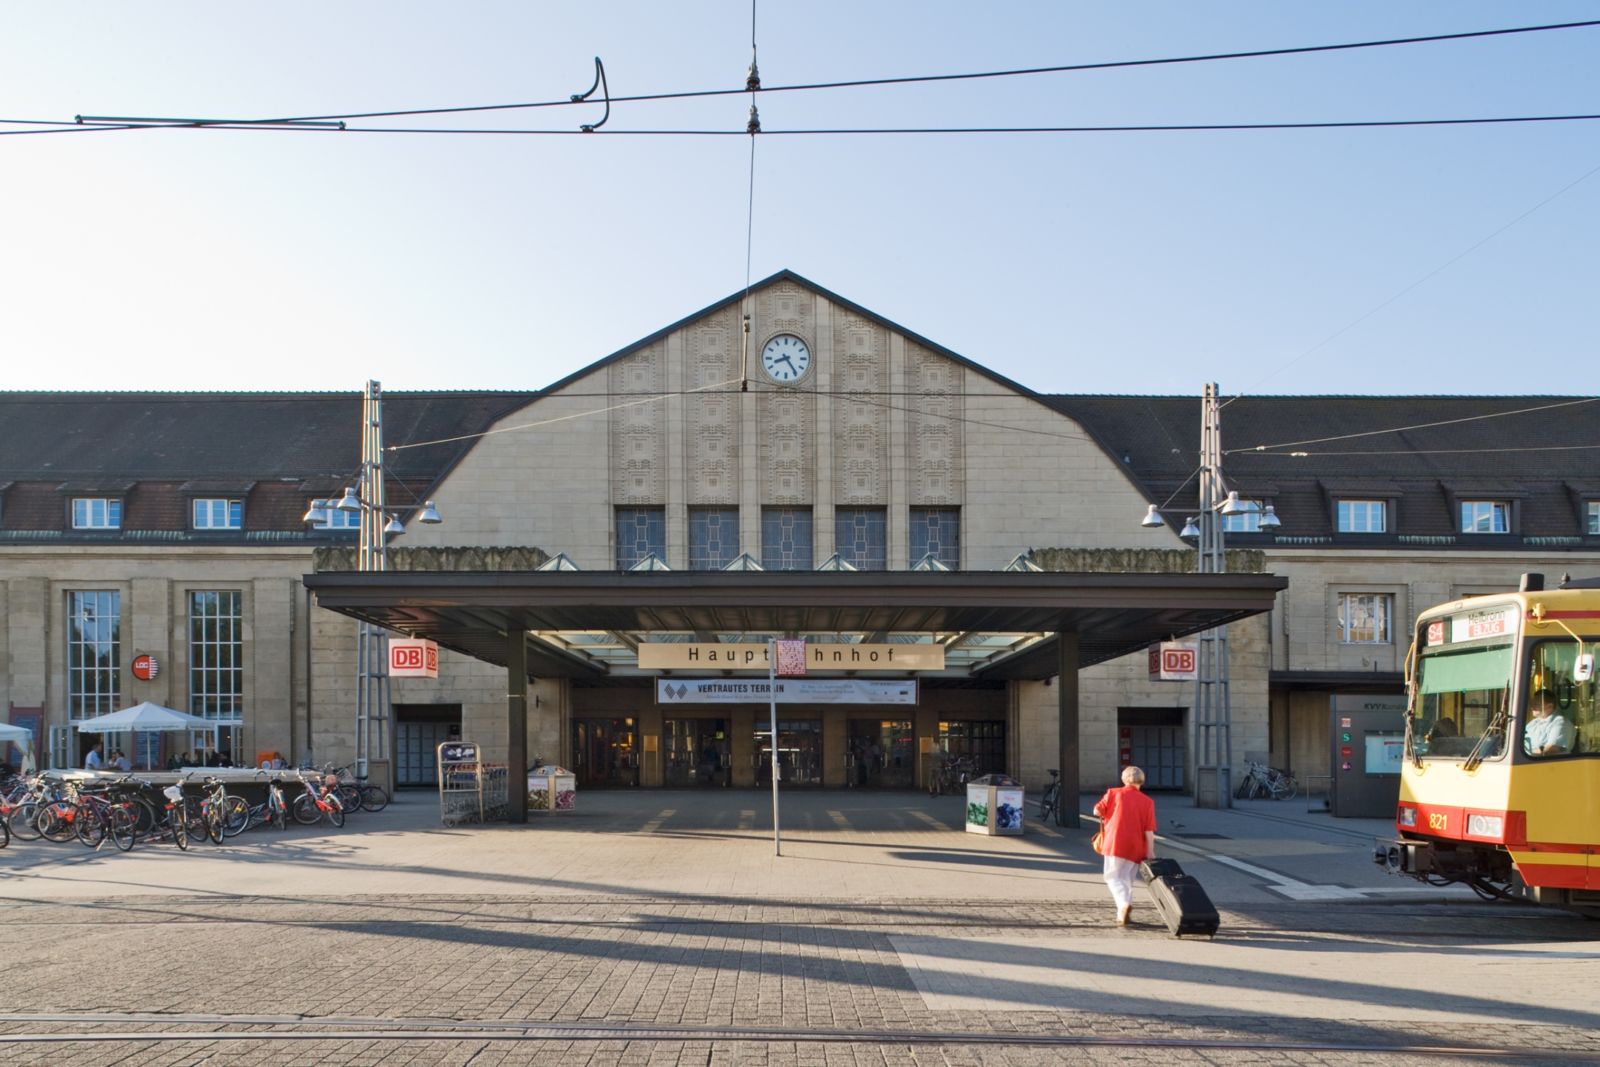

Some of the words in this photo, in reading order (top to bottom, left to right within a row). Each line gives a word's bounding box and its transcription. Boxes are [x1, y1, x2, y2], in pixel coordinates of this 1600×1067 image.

[1428, 624, 1443, 640] S4
[396, 650, 420, 665] DB
[427, 650, 436, 667] DB
[688, 647, 894, 664] Haupthnhof
[1166, 653, 1192, 668] DB
[697, 684, 748, 693] VERTRAUTES
[751, 684, 784, 693] TERRIN
[1429, 813, 1447, 831] 821
